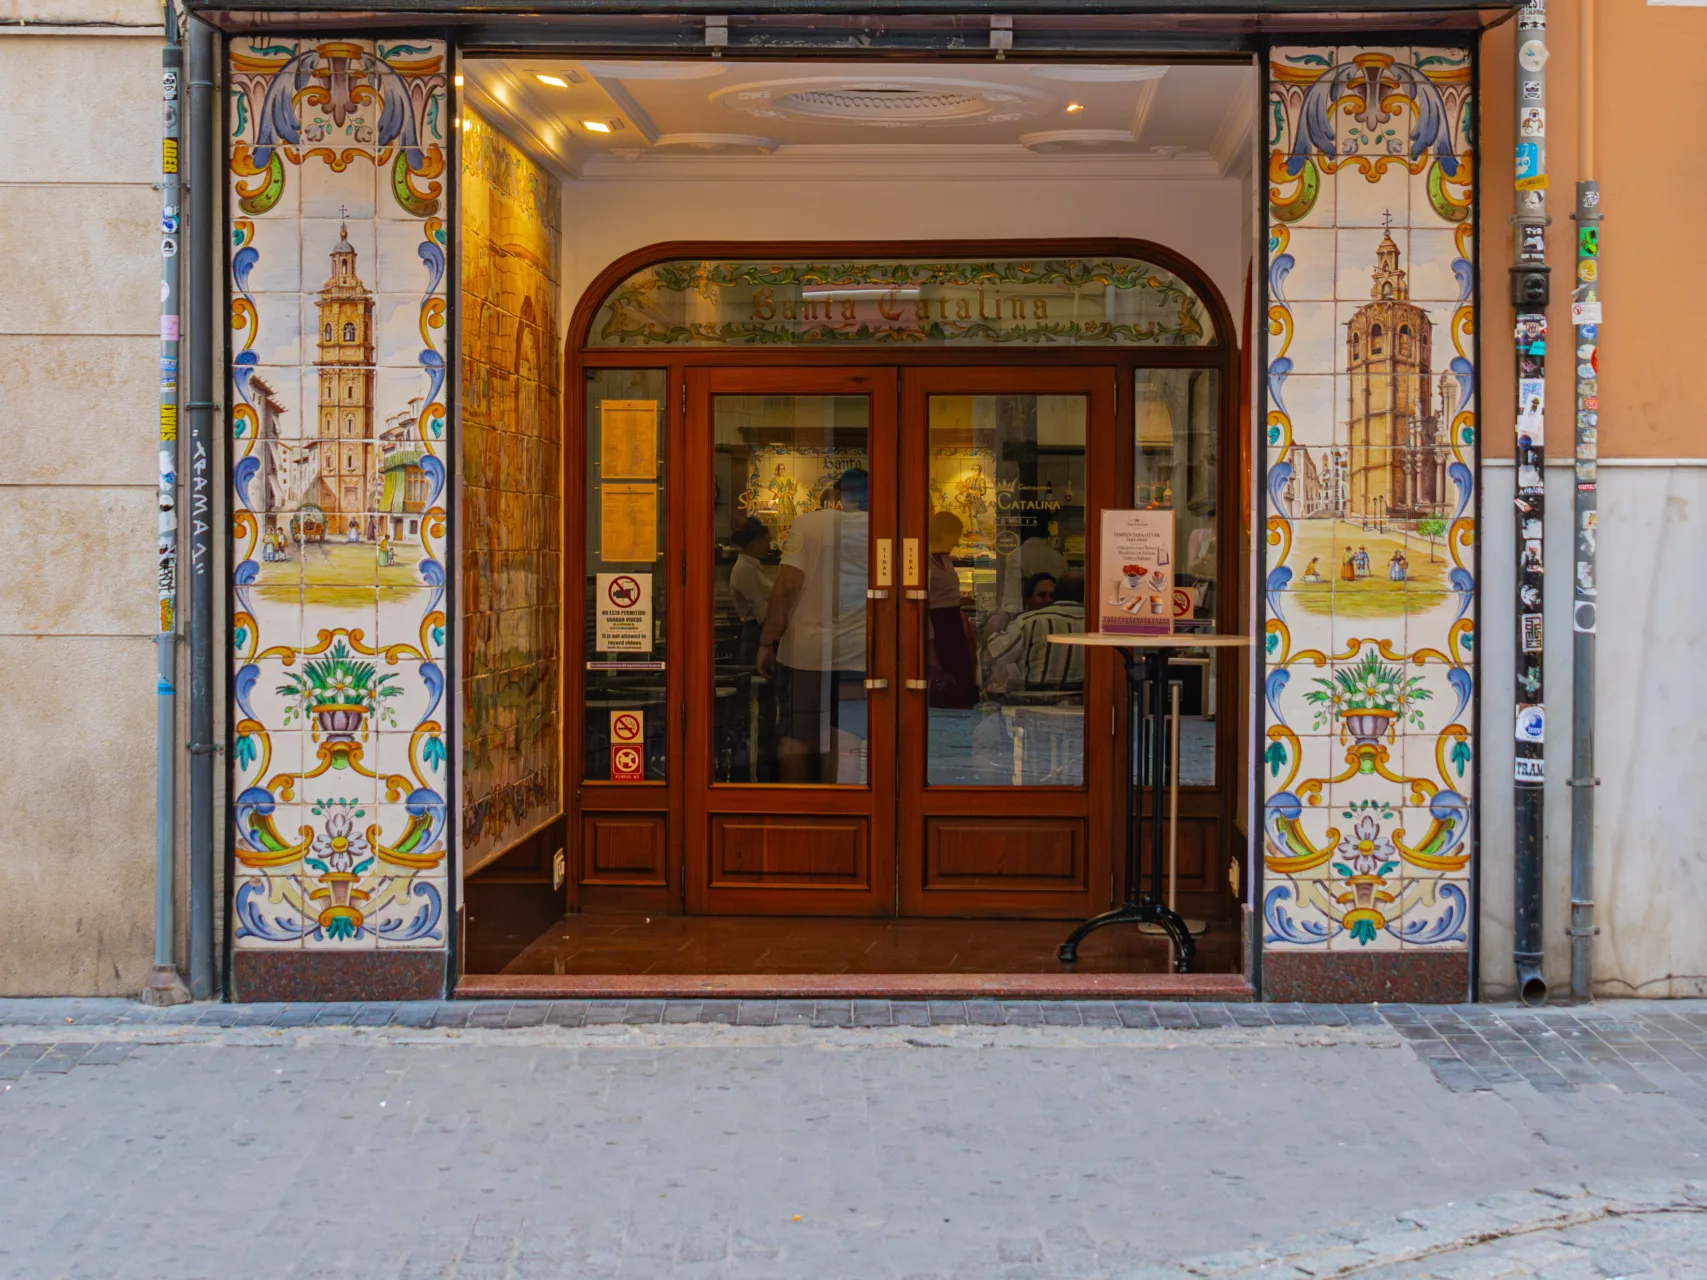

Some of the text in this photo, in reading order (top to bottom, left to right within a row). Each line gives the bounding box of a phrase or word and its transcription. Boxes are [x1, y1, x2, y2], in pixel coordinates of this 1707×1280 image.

[750, 287, 1049, 320] Santa Catalina
[997, 492, 1061, 510] CATALINA
